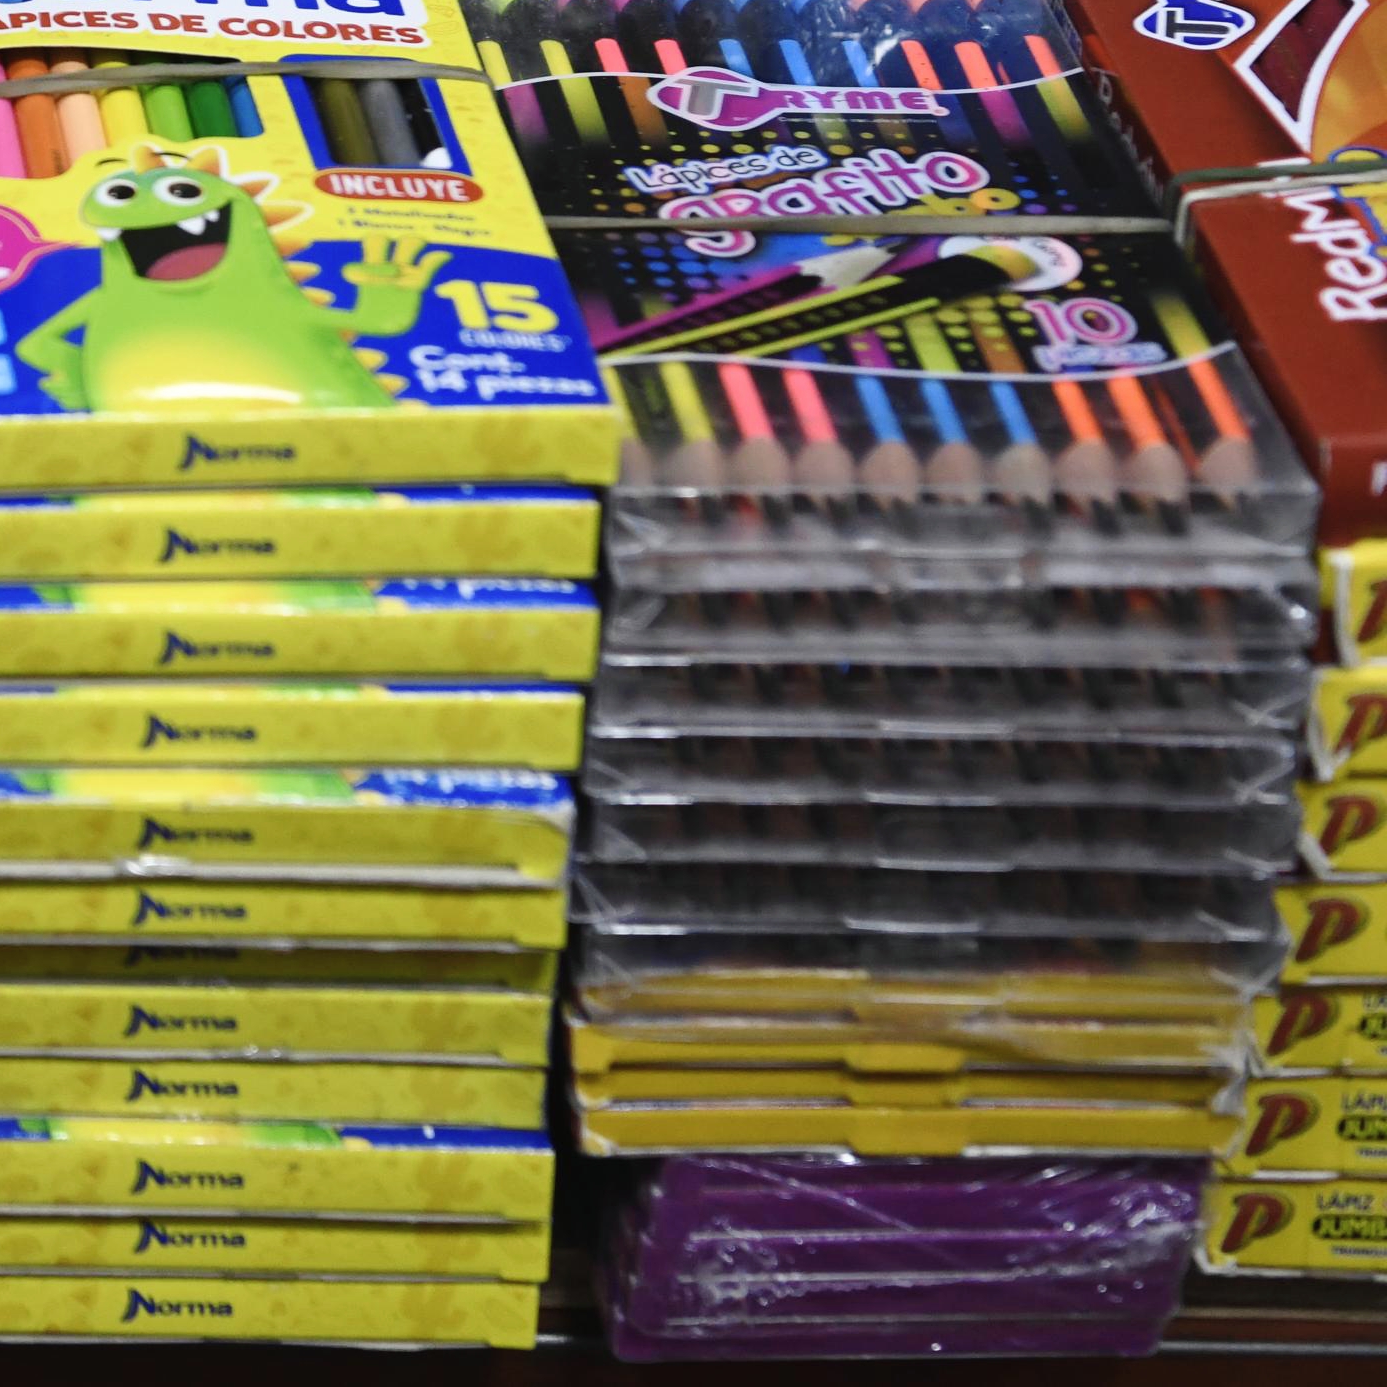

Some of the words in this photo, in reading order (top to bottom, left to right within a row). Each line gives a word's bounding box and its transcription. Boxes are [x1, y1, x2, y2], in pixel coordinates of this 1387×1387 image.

[156, 12, 209, 37] DE
[217, 17, 426, 47] COLORES
[673, 76, 929, 120] TRYME
[328, 173, 470, 203] INCLUYE
[631, 157, 769, 191] Lápices
[776, 147, 825, 171] de
[433, 279, 560, 335] 15
[1024, 297, 1138, 346] 10
